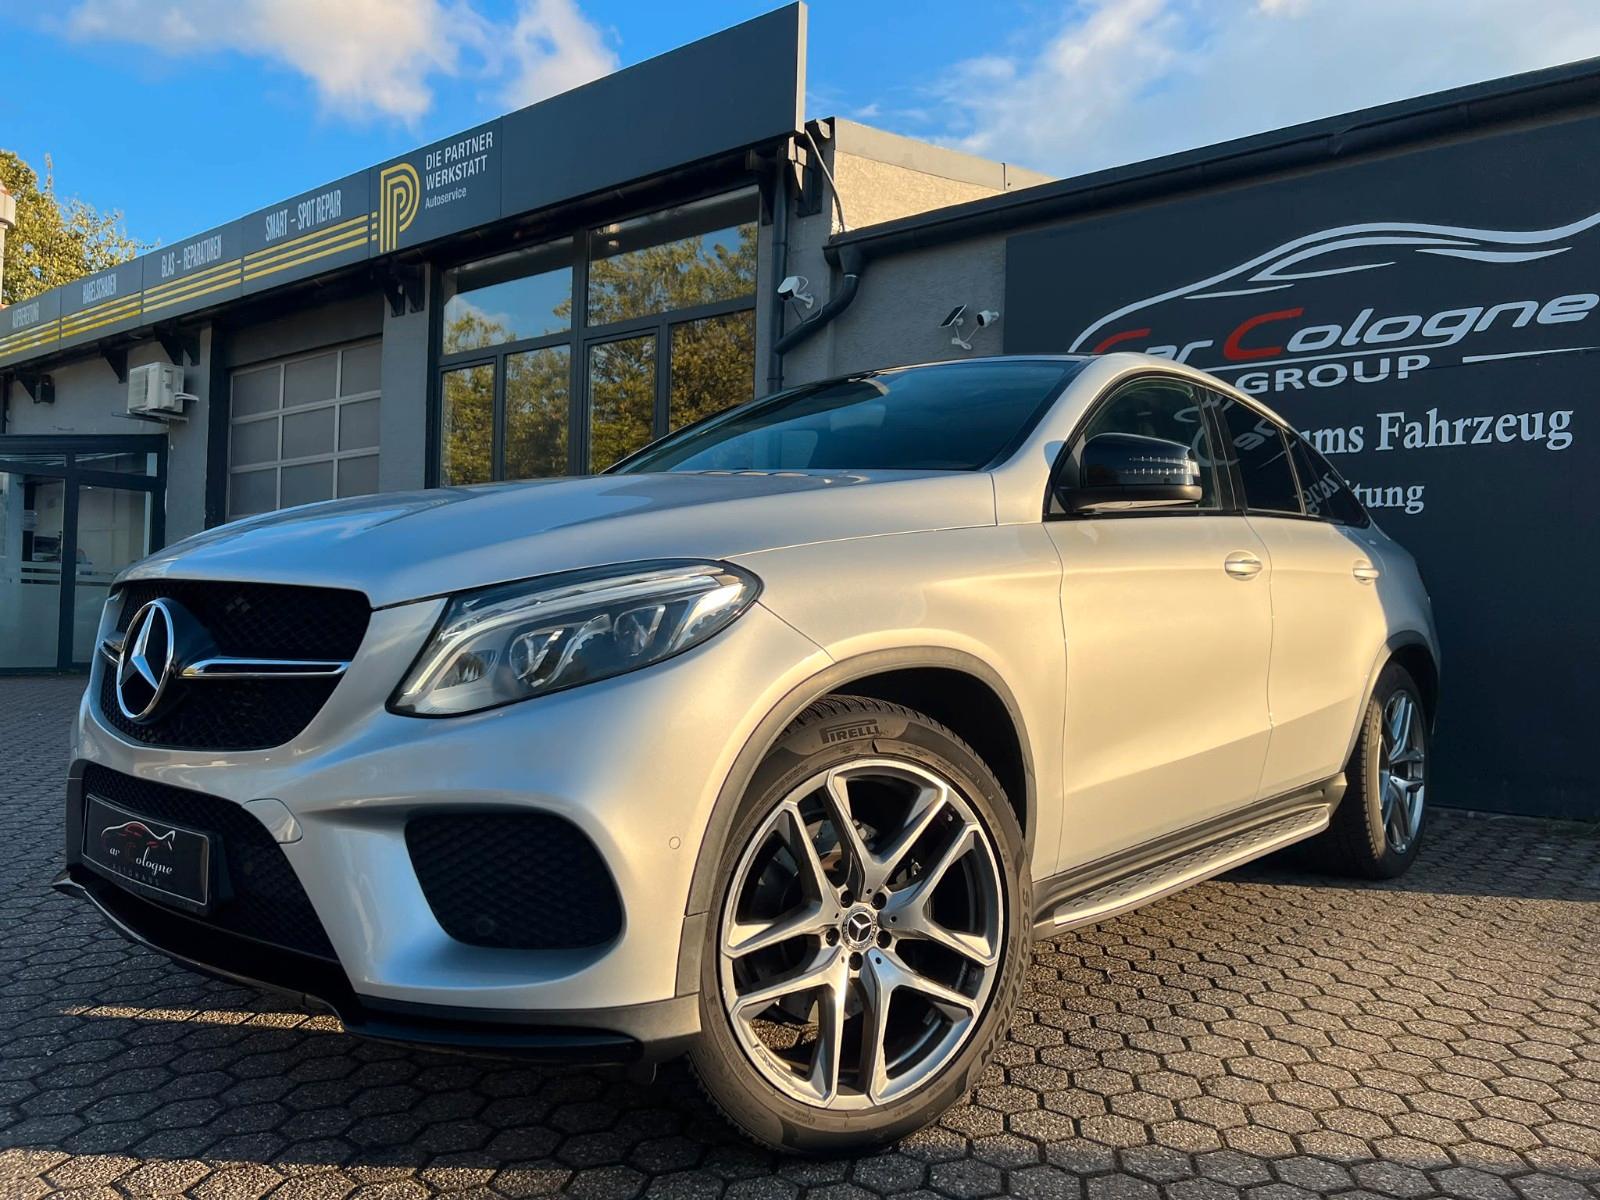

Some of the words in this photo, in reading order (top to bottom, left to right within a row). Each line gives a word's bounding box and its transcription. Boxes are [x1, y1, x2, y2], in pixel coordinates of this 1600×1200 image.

[426, 150, 442, 171] DIE
[445, 131, 493, 163] PARTNER
[426, 155, 488, 191] WERKSTATT
[265, 209, 288, 242] SMART
[297, 199, 316, 231] SPOT
[316, 189, 342, 224] REPAIR
[425, 187, 467, 209] Autoservice
[161, 252, 175, 278] GLAS
[1223, 293, 1600, 361] Cologne
[1234, 354, 1431, 395] GROUP
[1375, 407, 1574, 451] Fahrzeug
[819, 718, 880, 744] PIRELLI
